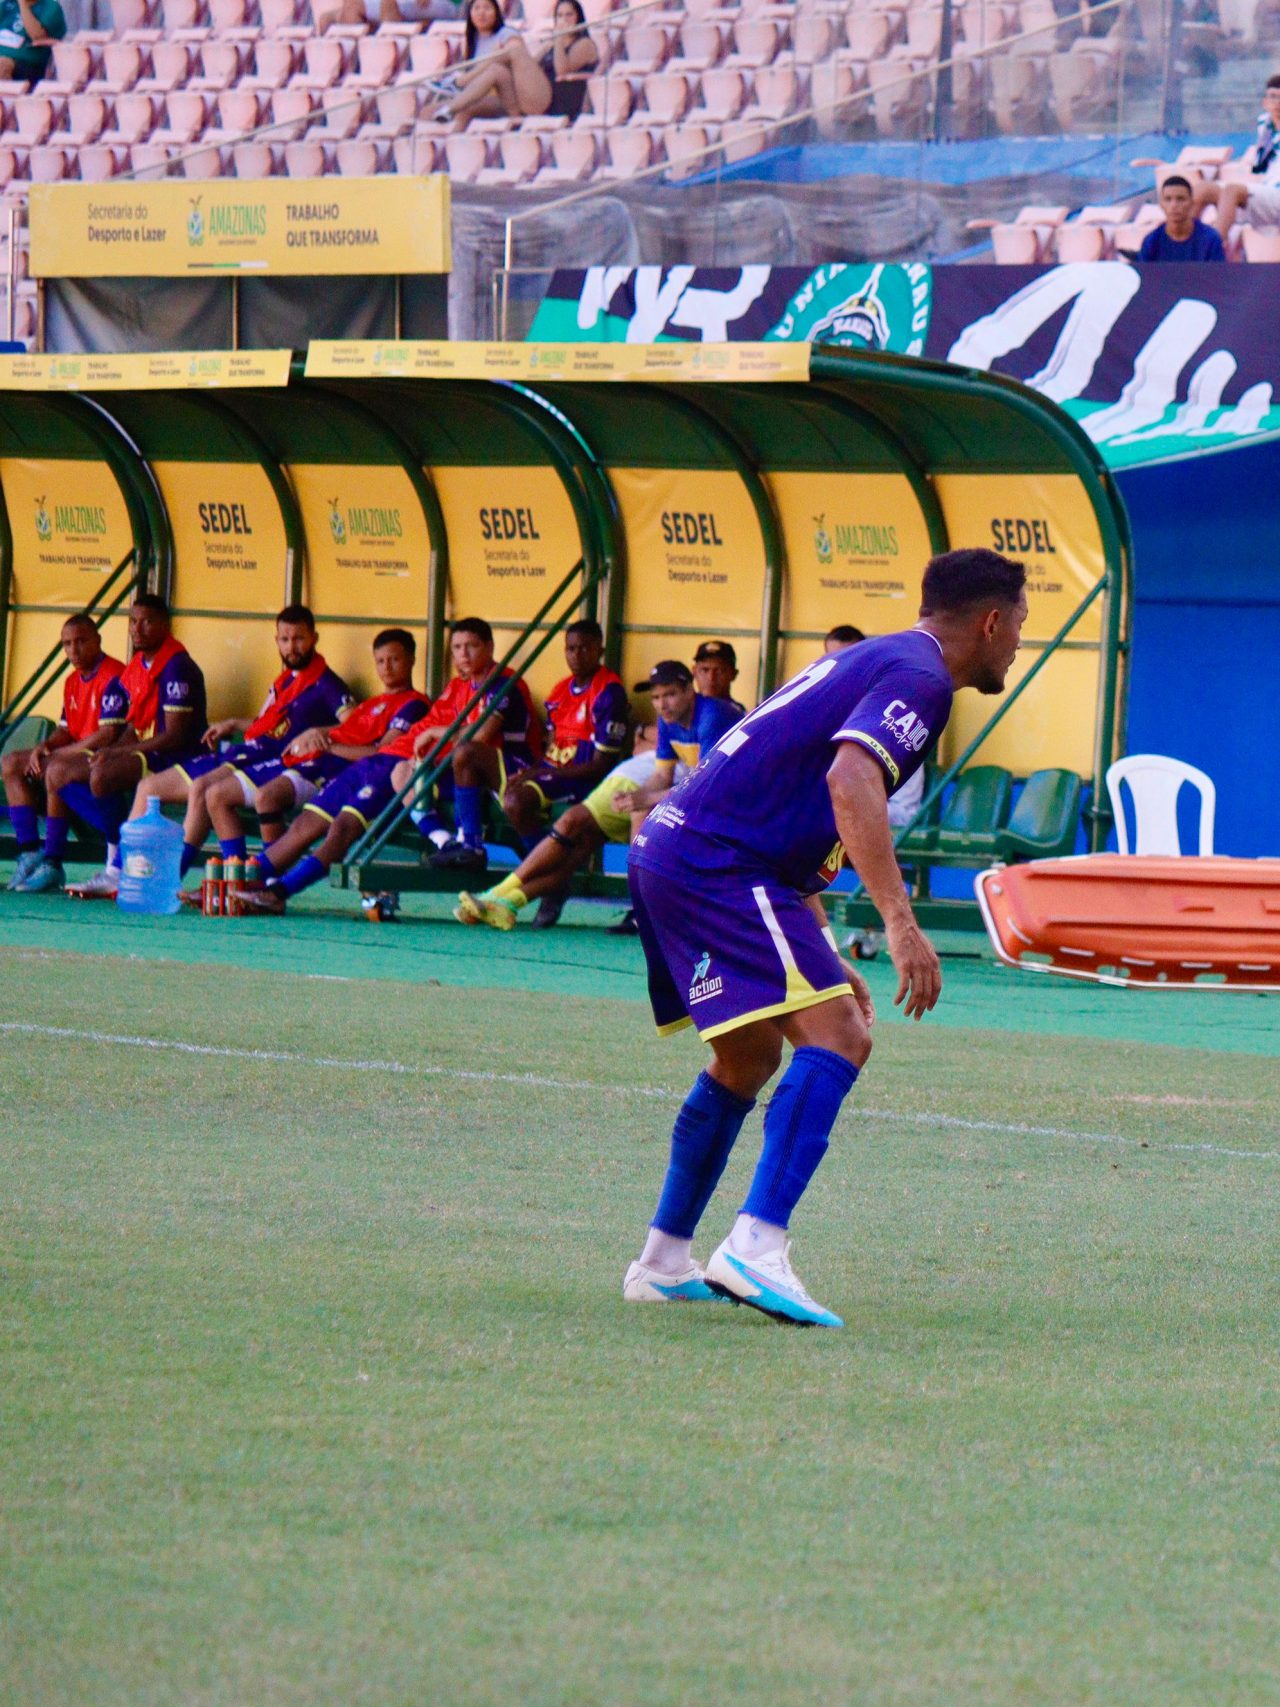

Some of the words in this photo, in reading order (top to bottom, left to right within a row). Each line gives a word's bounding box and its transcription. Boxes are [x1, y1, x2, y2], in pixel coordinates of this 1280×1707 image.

[87, 203, 131, 220] Secretaria
[134, 204, 148, 219] do
[209, 204, 267, 236] AMAZONAS
[286, 204, 340, 222] TRABALHO
[87, 227, 132, 245] Desporto
[133, 230, 140, 242] e
[141, 227, 166, 243] Lazer
[286, 231, 308, 248] QUE
[310, 229, 380, 247] TRANSFORMA
[55, 506, 106, 535] AMAZONAS
[198, 502, 252, 535] SEDEL
[348, 507, 402, 538] AMAZONAS
[479, 507, 540, 541] SEDEL
[661, 511, 723, 546] SEDEL
[835, 525, 898, 556] AMAZONAS
[991, 518, 1056, 554] SEDEL
[689, 976, 723, 1000] action
